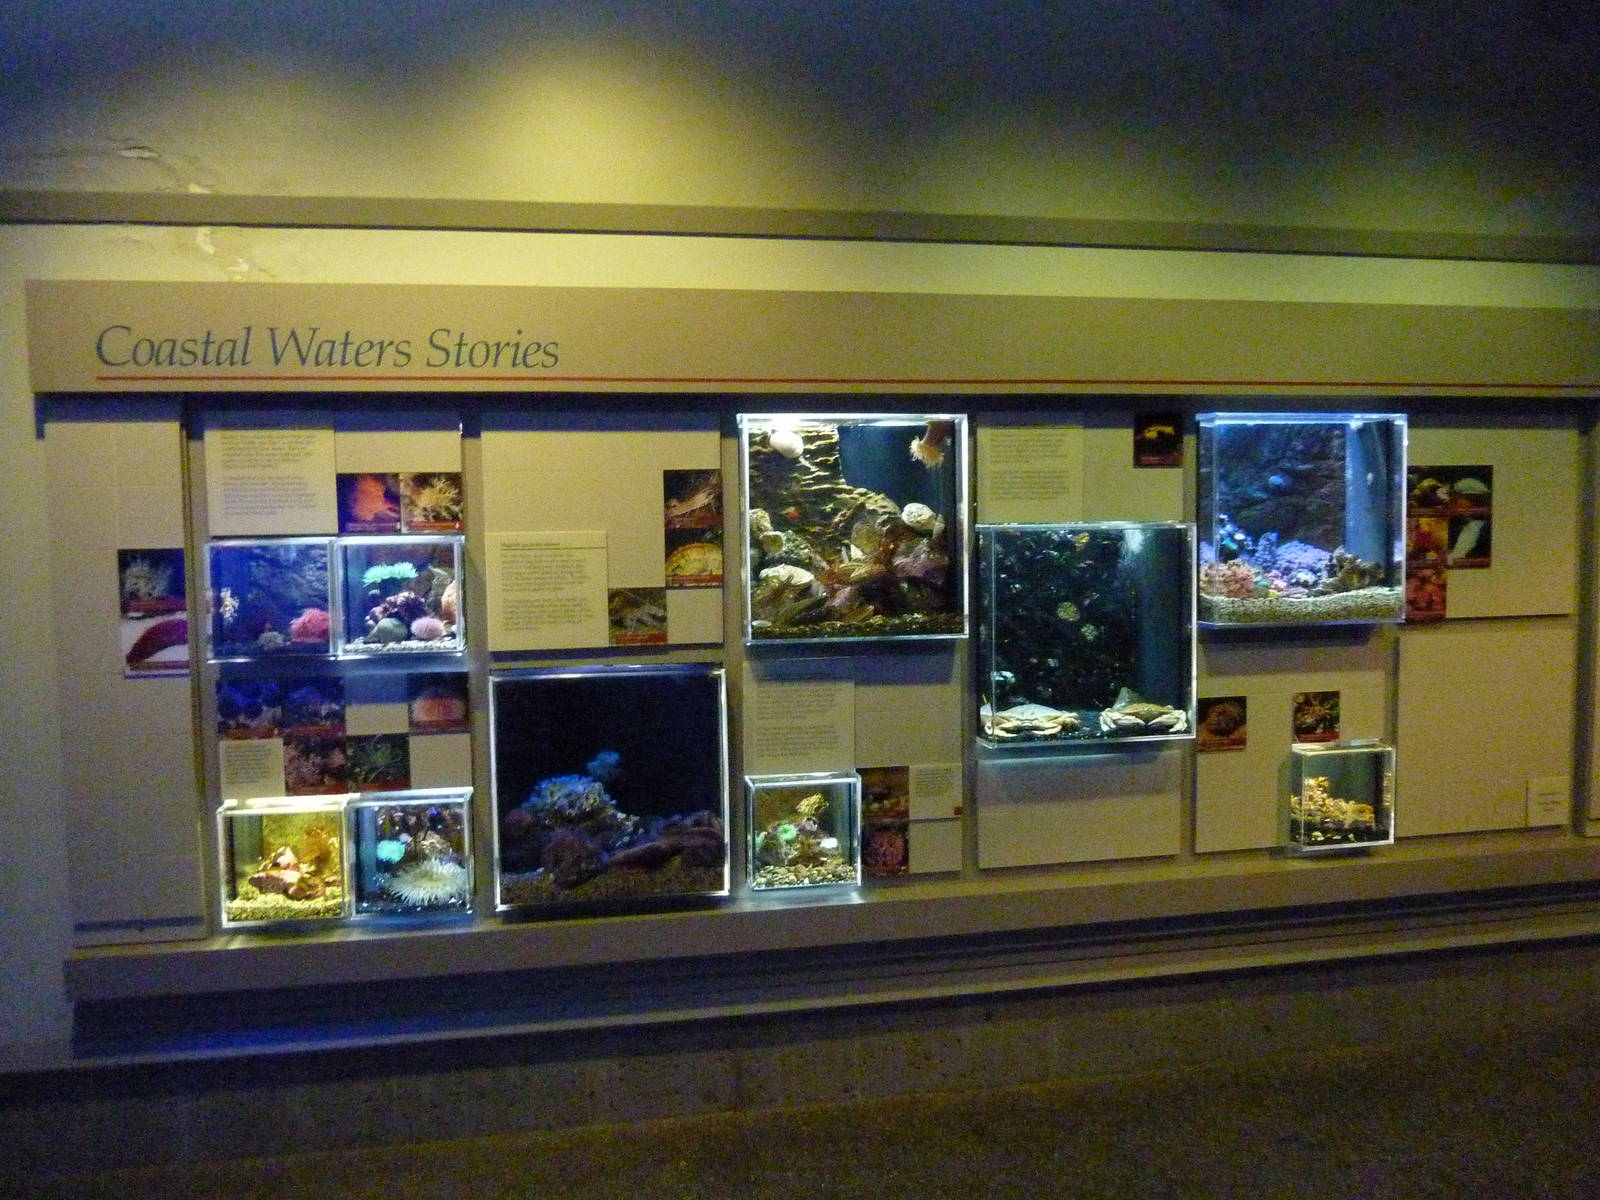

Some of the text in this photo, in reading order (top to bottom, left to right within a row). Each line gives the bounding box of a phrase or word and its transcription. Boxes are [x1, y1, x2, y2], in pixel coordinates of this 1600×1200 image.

[95, 325, 559, 368] Coastal Waters Stories
